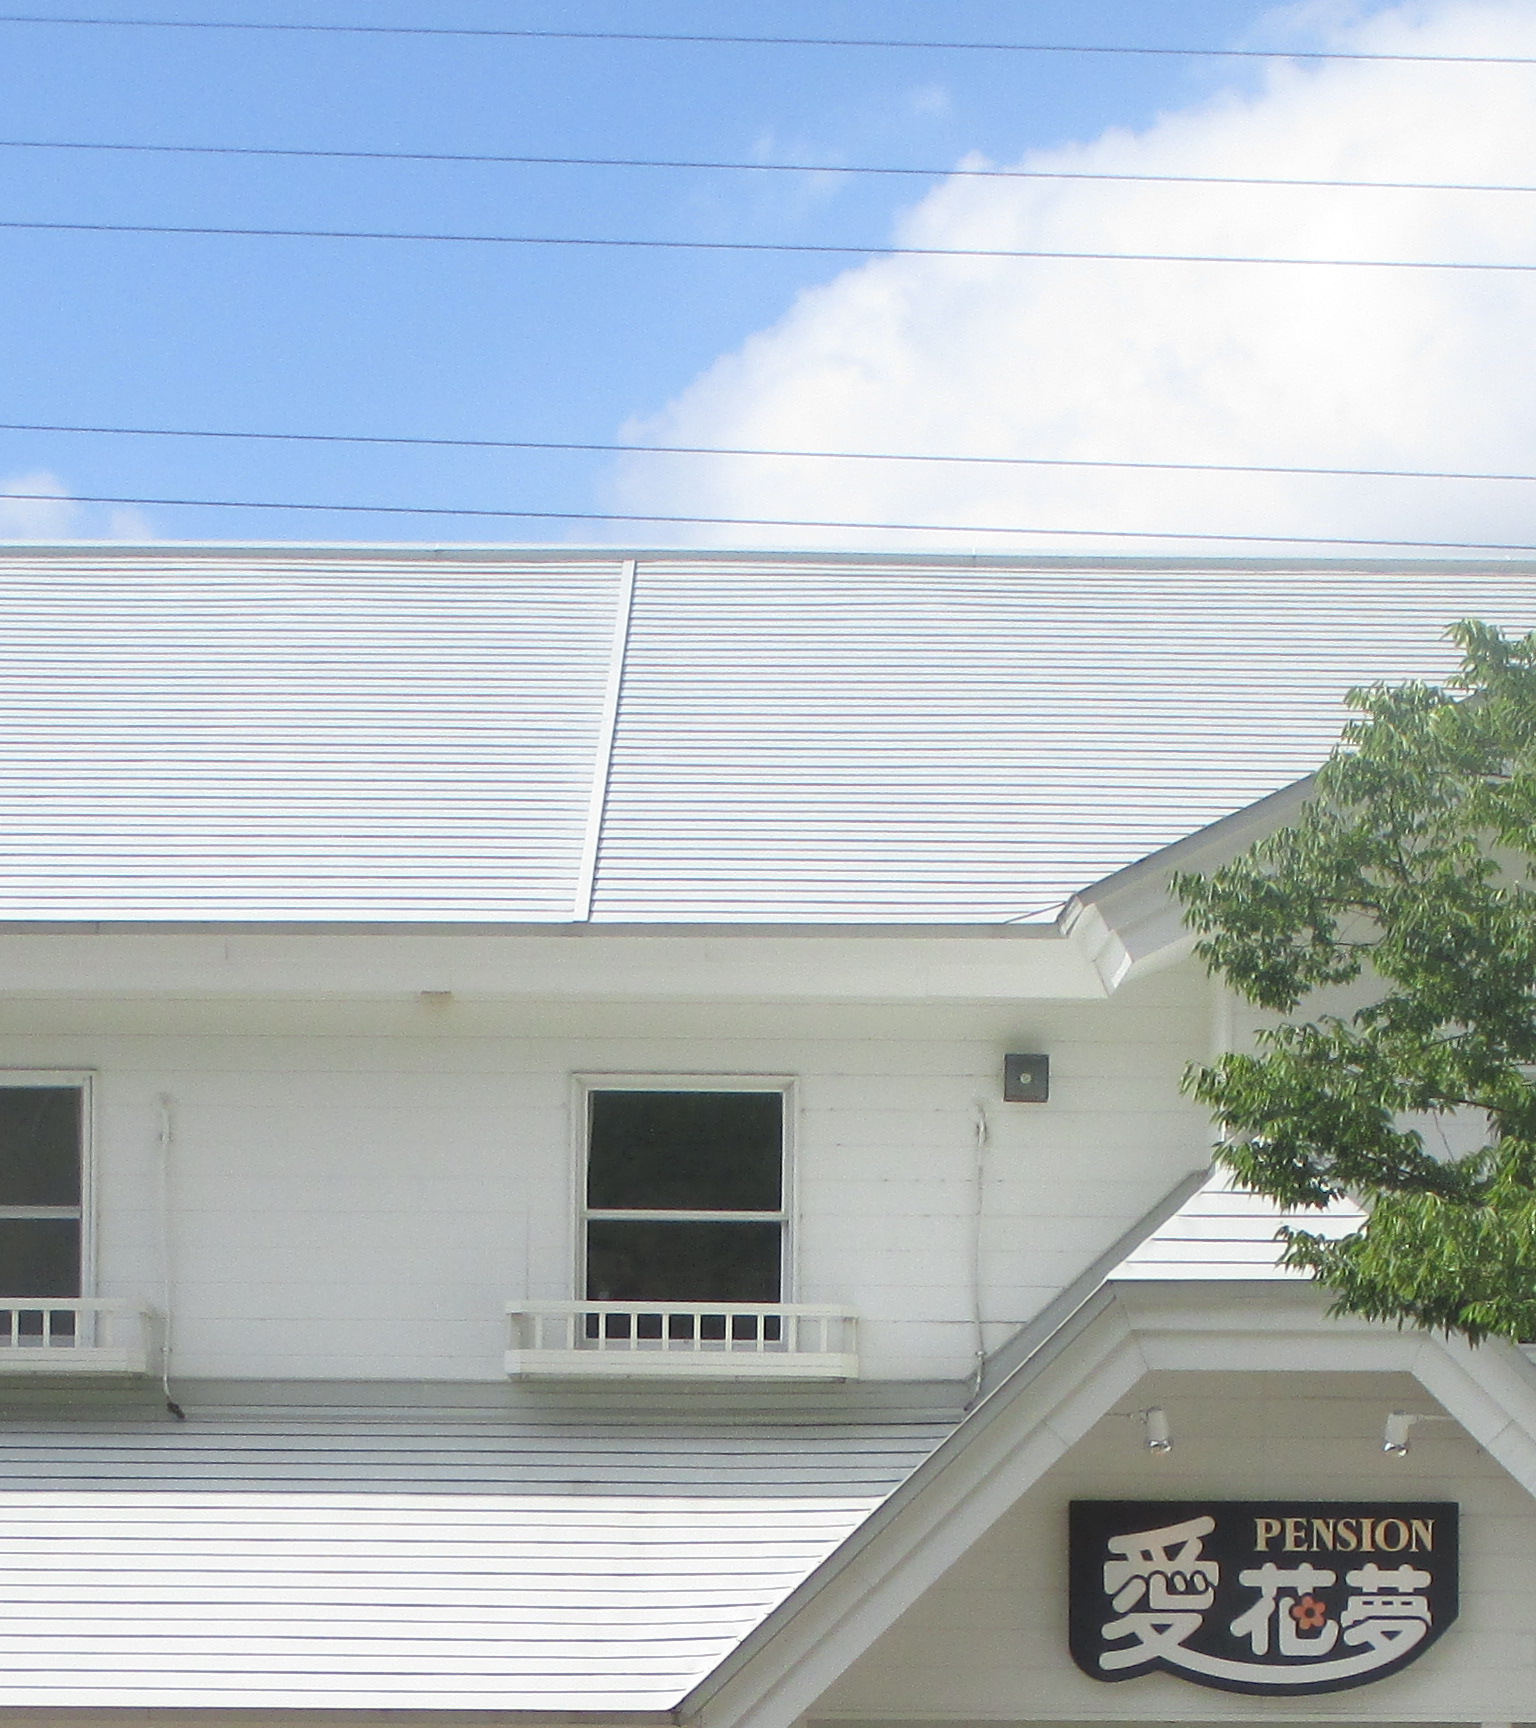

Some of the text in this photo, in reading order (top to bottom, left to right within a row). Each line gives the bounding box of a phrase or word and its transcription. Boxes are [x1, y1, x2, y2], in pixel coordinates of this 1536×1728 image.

[1253, 1516, 1436, 1553] PENSION
[1098, 1515, 1433, 1685] 愛花夢
